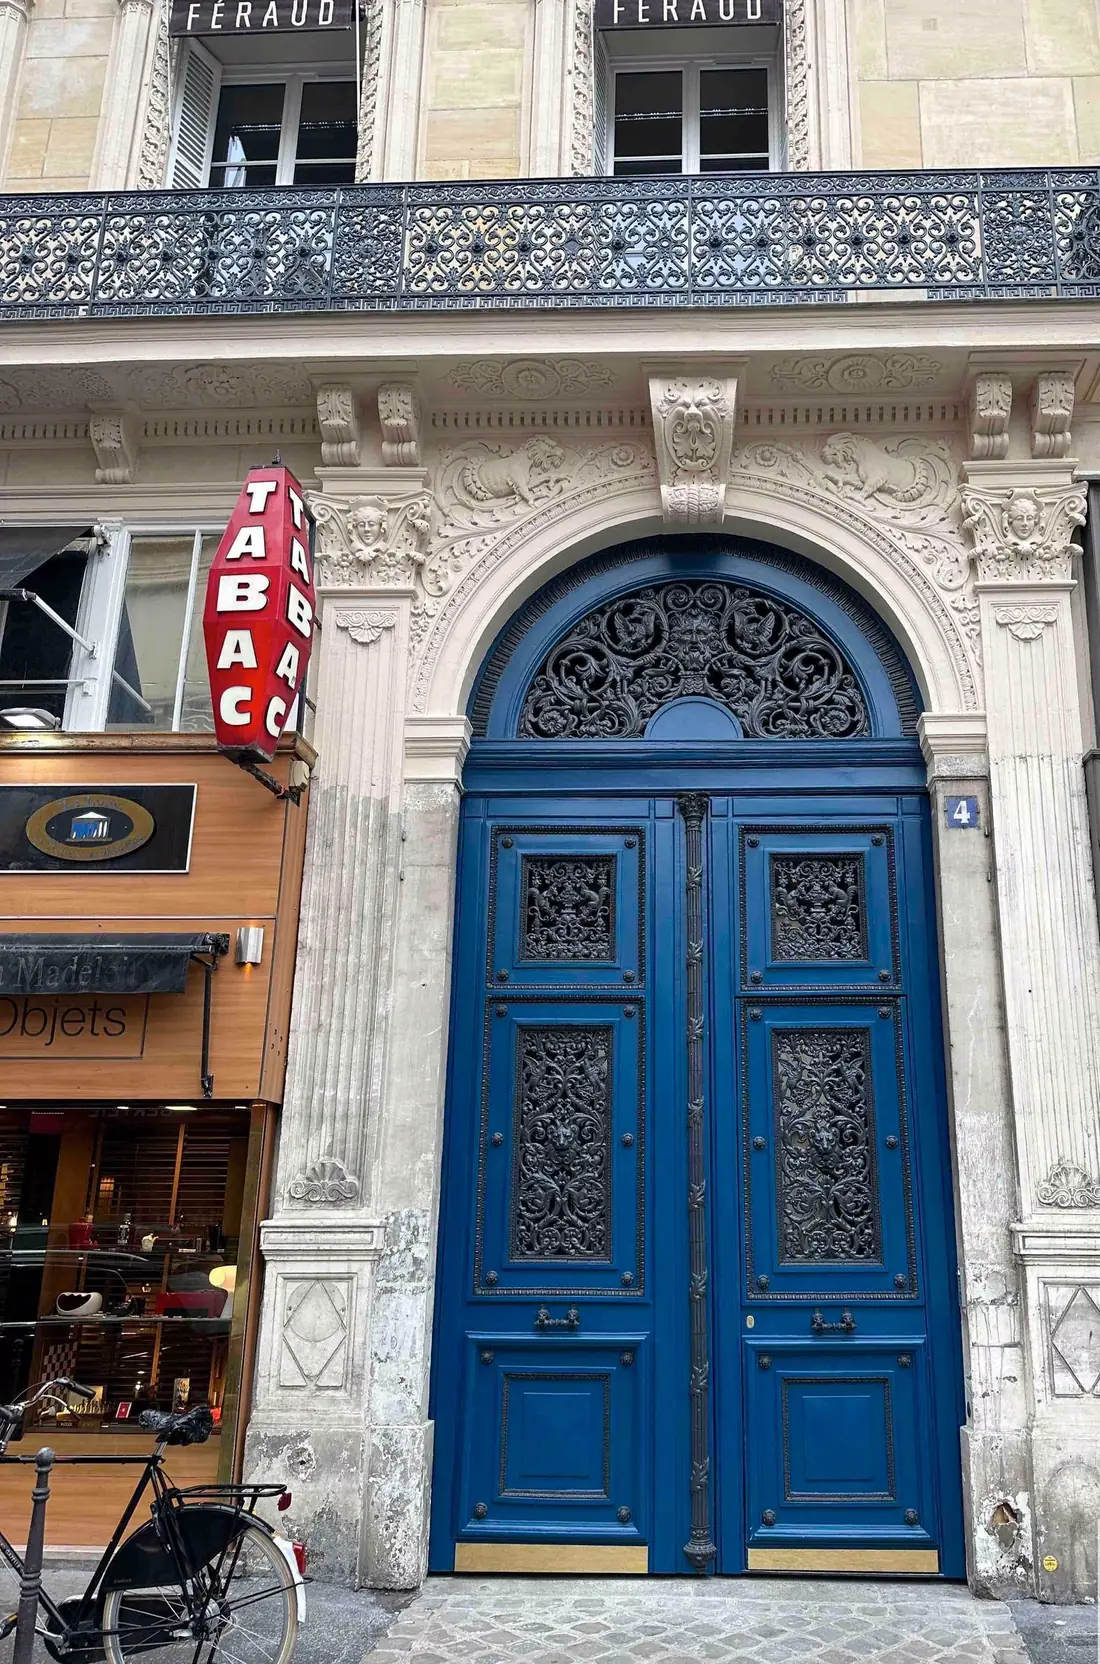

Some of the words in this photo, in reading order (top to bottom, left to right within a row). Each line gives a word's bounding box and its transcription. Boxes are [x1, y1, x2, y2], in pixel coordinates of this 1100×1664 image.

[186, 0, 335, 31] FÉRAUD
[216, 481, 278, 726] TABAC
[265, 486, 313, 738] TABAC
[953, 800, 970, 824] 4
